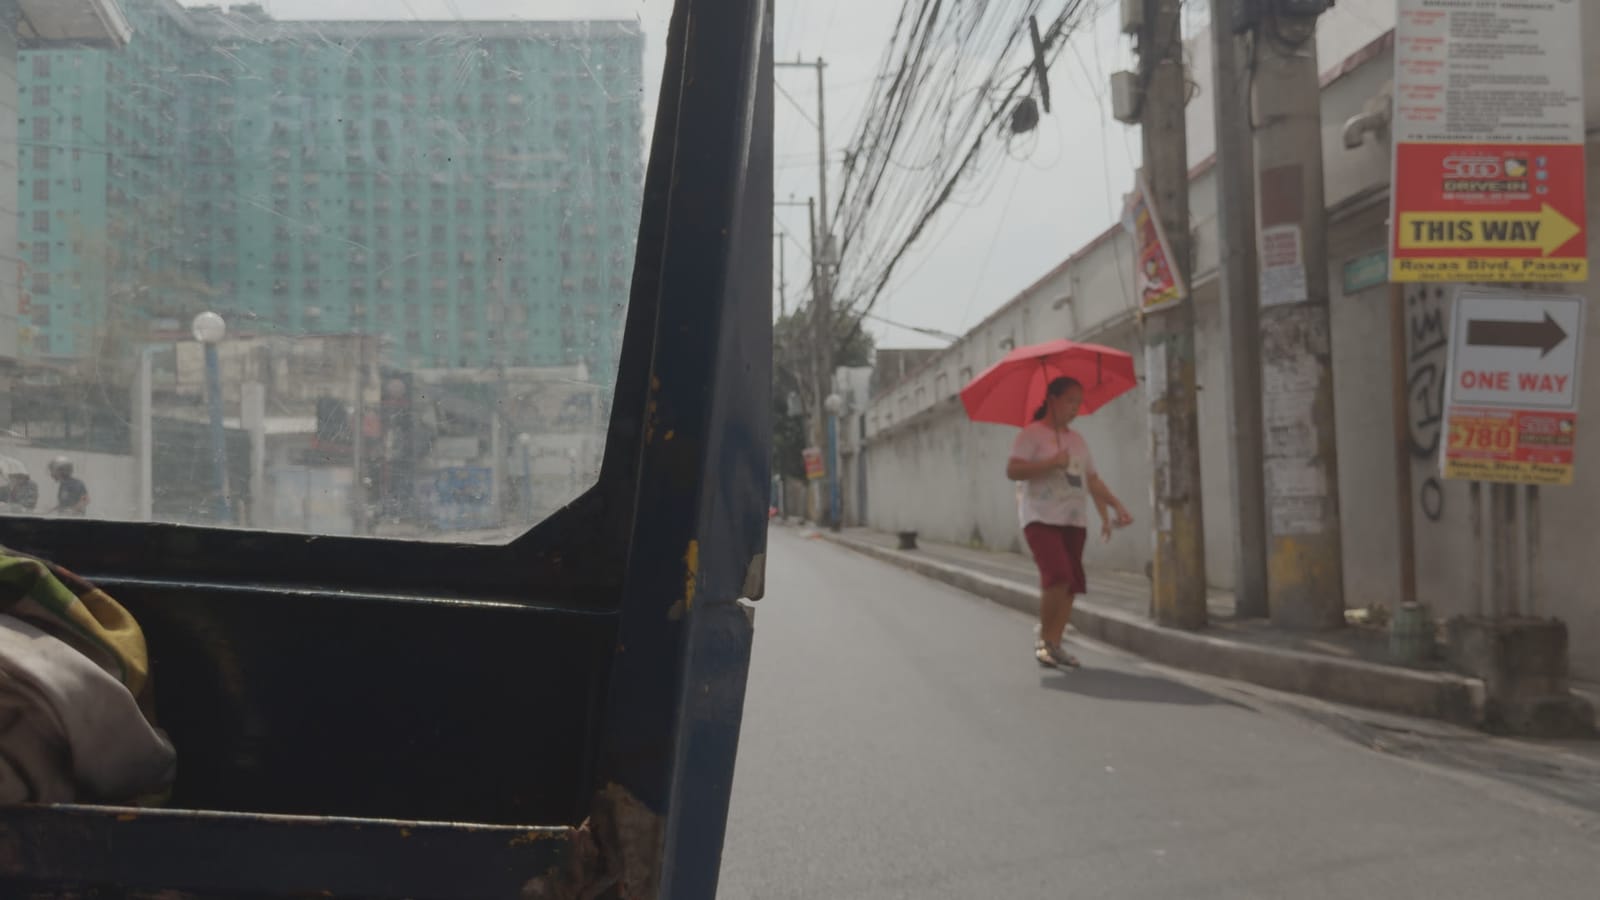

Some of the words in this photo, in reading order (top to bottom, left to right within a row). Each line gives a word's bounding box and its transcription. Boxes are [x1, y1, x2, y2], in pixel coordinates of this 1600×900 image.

[1411, 221, 1473, 241] THIS
[1480, 221, 1541, 242] WAY
[1522, 259, 1581, 273] Pasay
[1460, 371, 1510, 391] ONE
[1517, 373, 1568, 393] WAY
